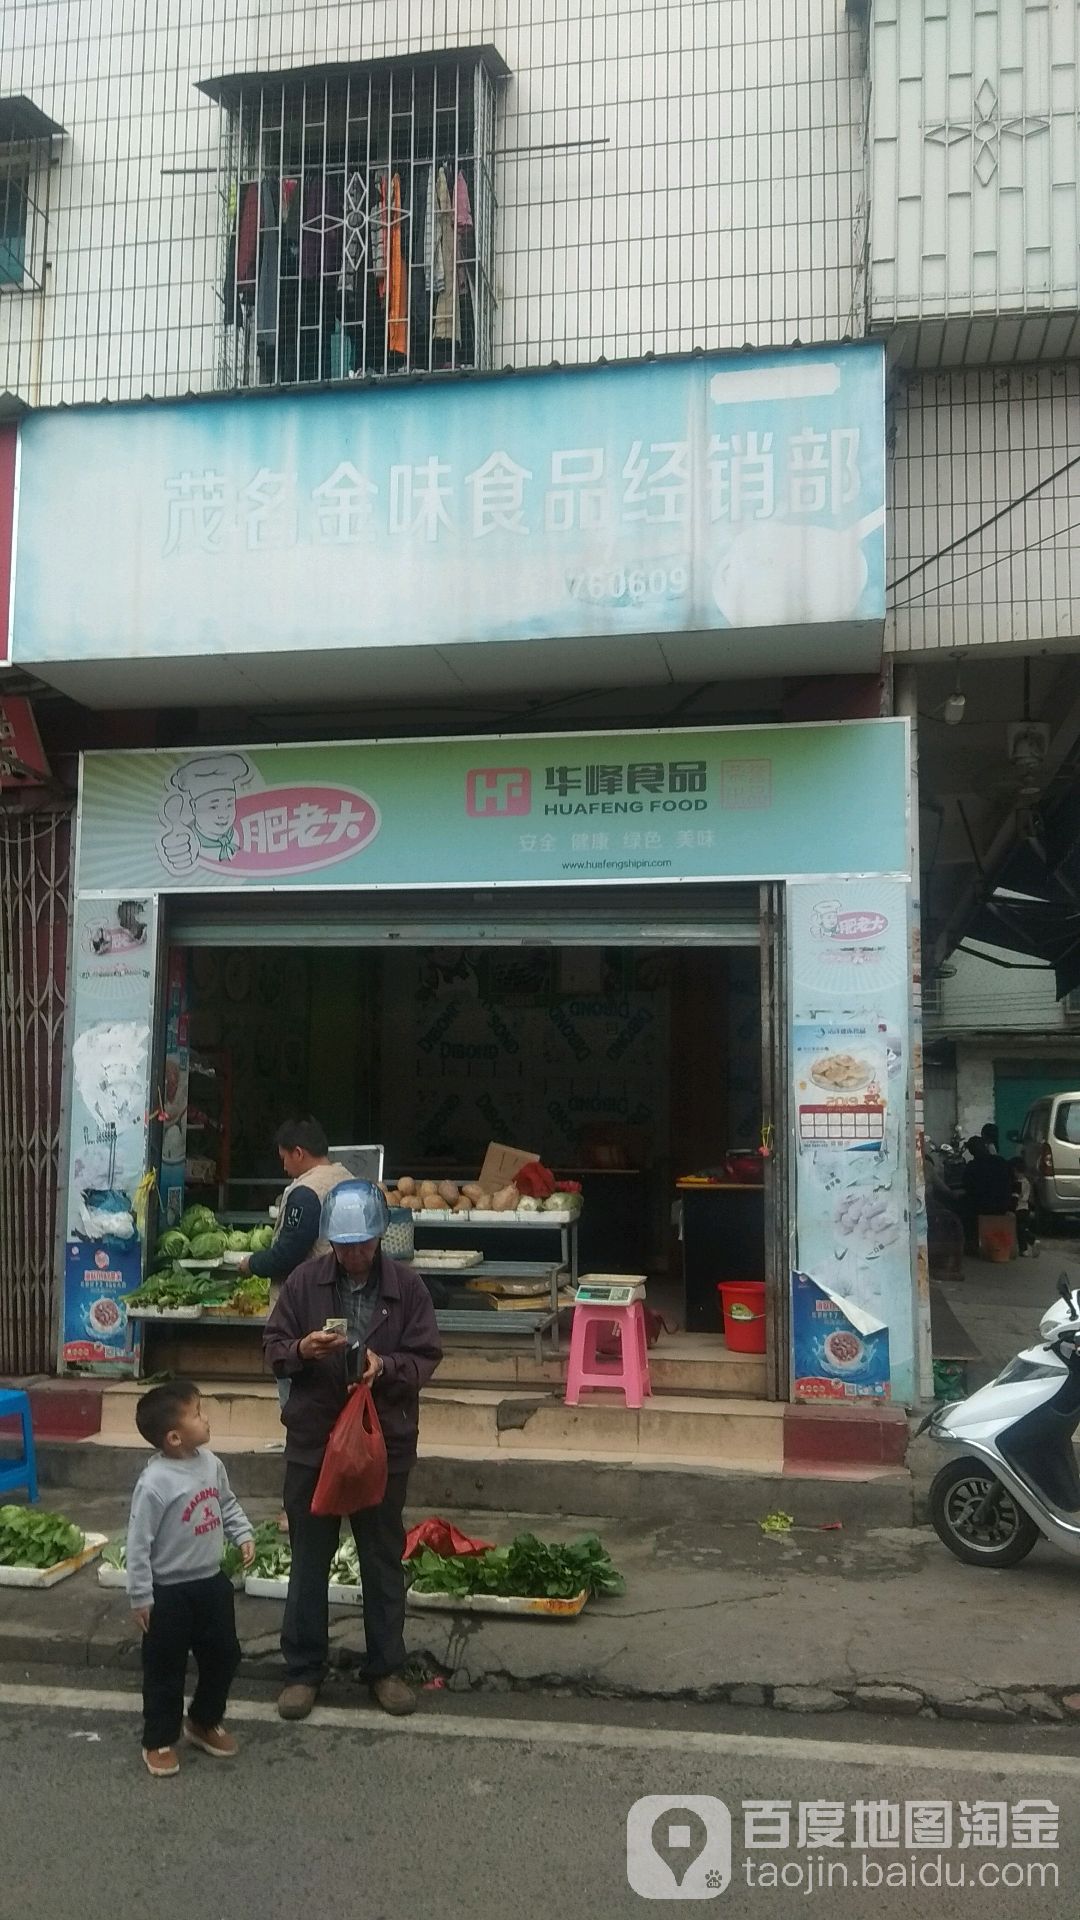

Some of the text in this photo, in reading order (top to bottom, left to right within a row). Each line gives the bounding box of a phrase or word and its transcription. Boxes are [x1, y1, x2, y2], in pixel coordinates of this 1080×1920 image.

[163, 426, 861, 557] 茂名金味食品经销部
[545, 760, 707, 797] 华峰食品
[545, 799, 708, 816] HUAFENG FOOD
[241, 800, 365, 855] 肥老大
[519, 829, 716, 852] 安全 健康 绿色 美味
[562, 859, 672, 870] www.huafengshipin.com
